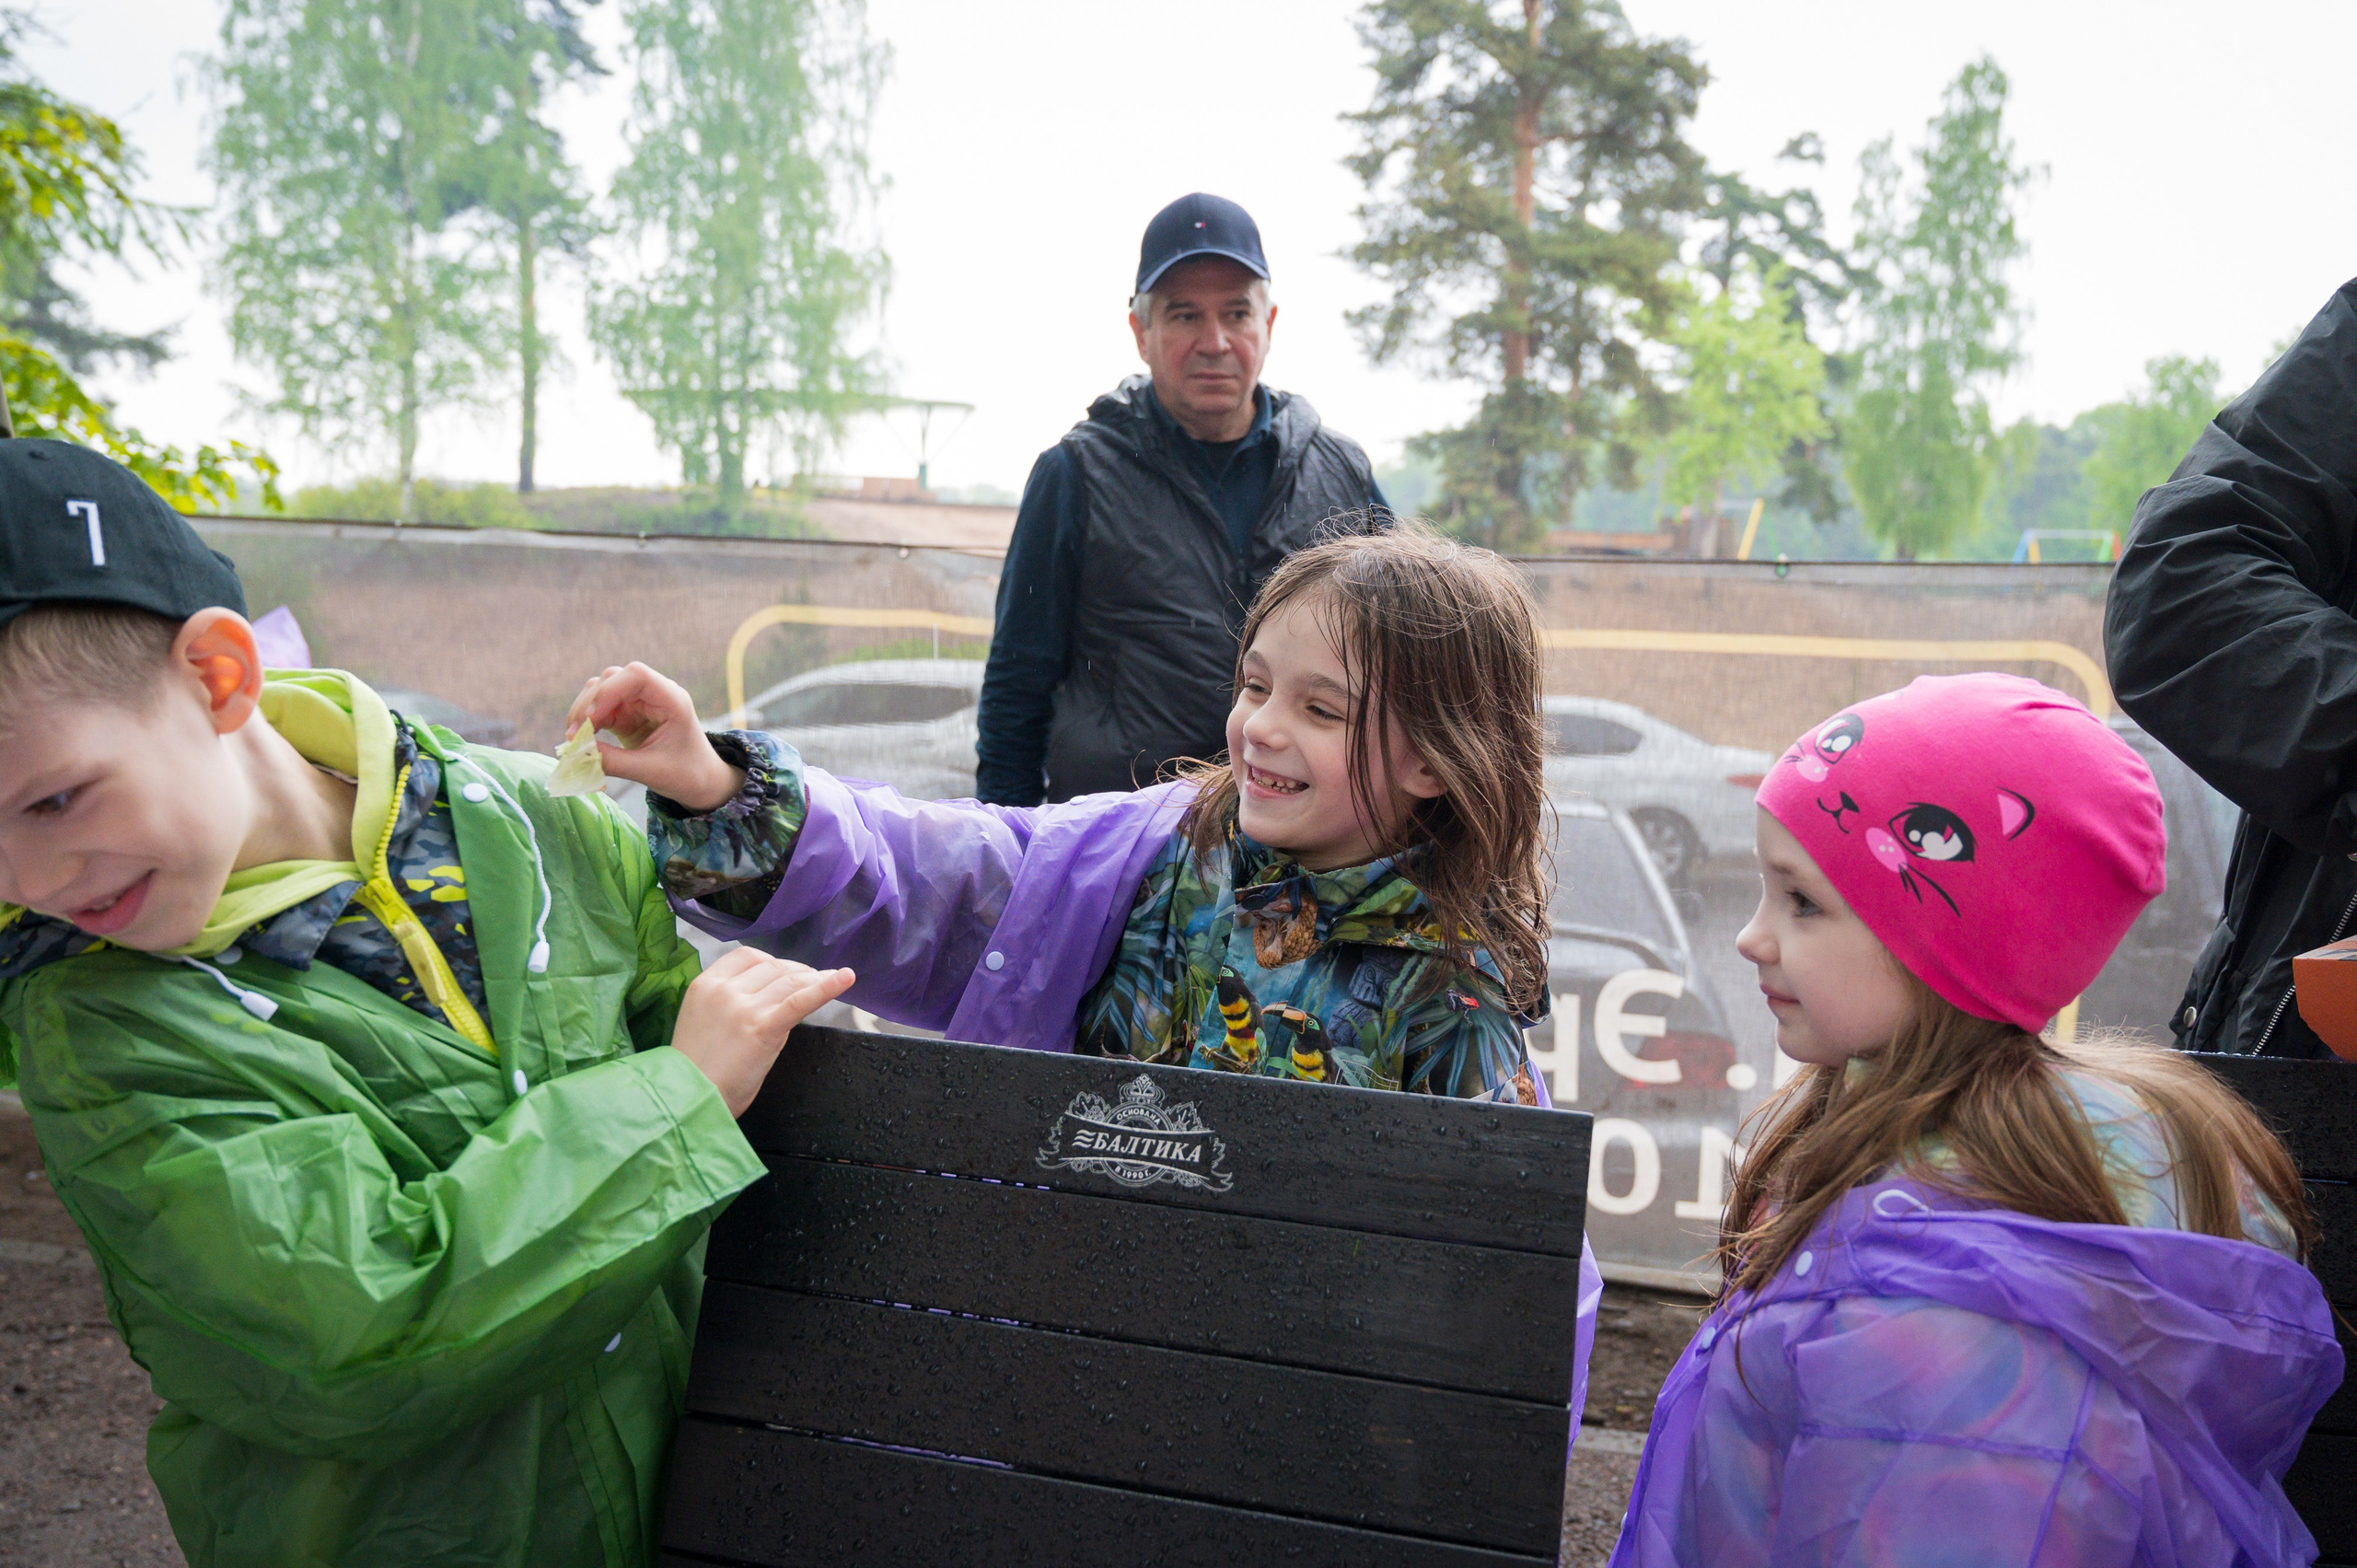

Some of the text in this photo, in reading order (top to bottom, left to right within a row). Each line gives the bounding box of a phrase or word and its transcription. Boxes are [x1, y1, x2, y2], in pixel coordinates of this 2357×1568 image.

[66, 499, 106, 566] 7
[1116, 1108, 1161, 1126] ОСНОВАНА
[1092, 1132, 1202, 1163] БАЛТИКА
[1122, 1169, 1144, 1179] 1990
